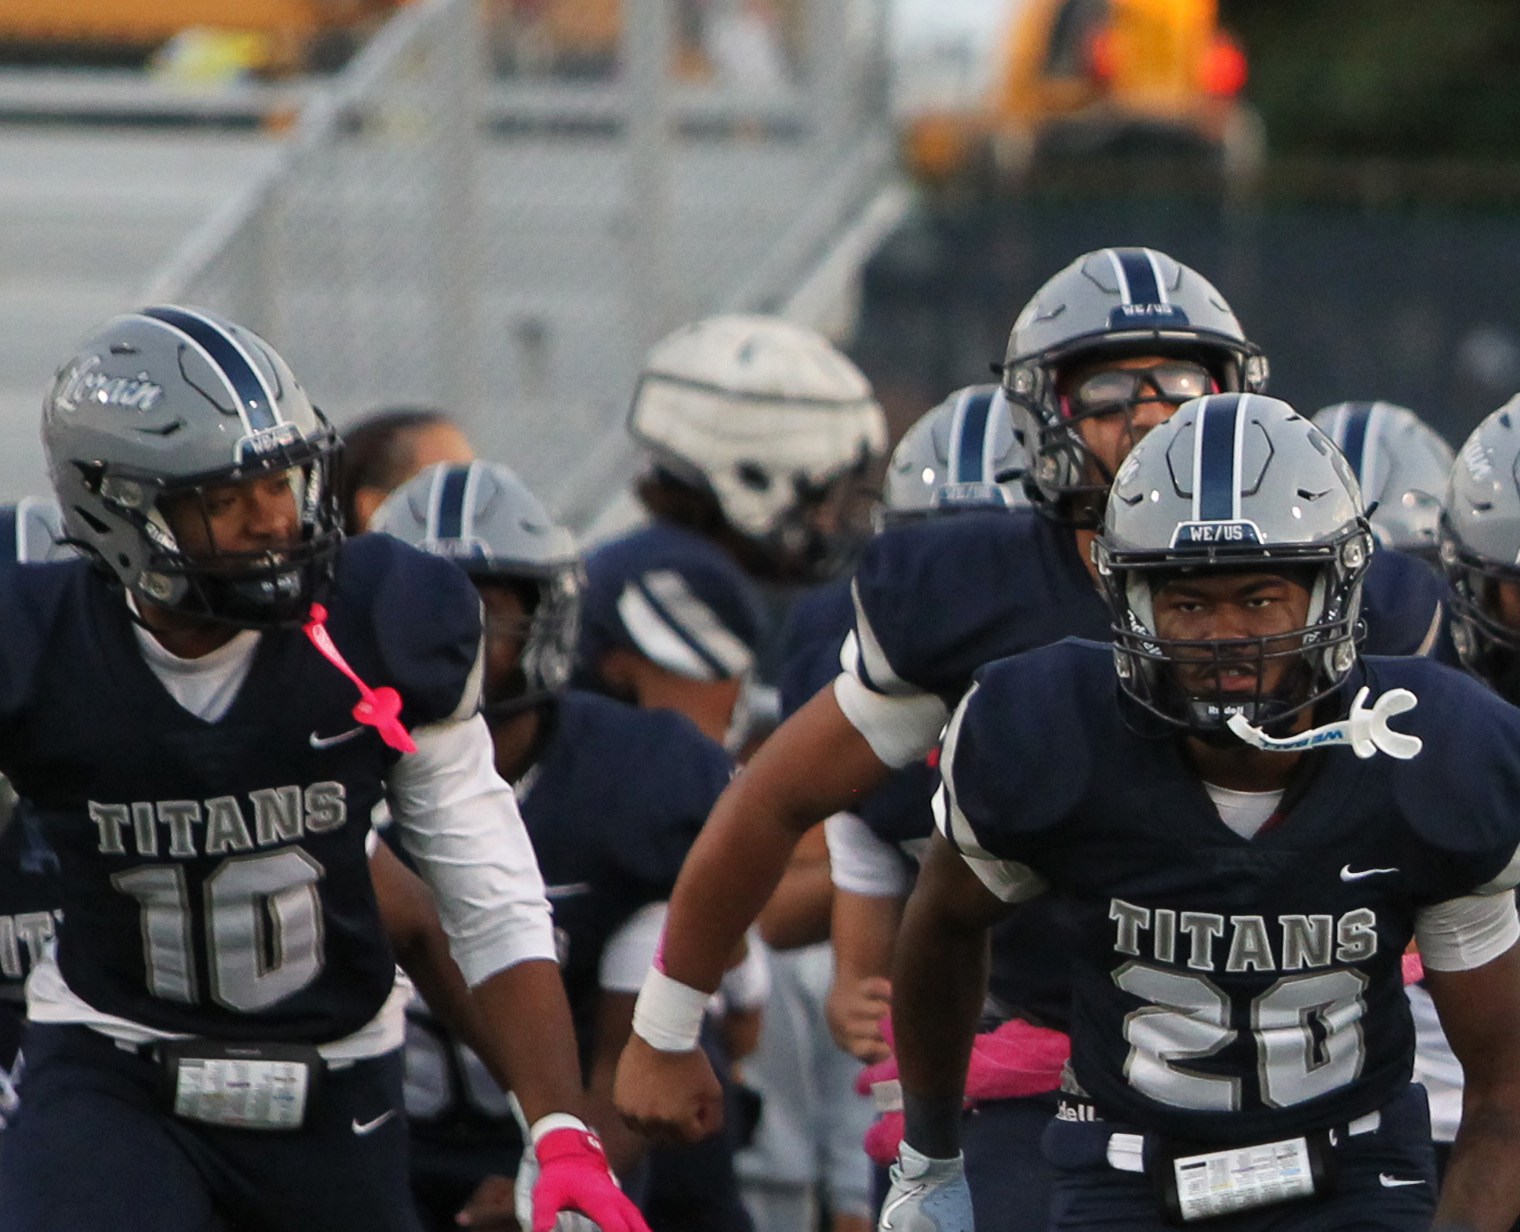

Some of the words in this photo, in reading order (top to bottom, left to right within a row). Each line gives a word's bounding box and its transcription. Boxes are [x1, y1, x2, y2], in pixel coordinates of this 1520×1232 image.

[1190, 525, 1243, 541] WE/US
[88, 781, 347, 857] TITANS
[110, 845, 326, 1013] 10
[1109, 898, 1378, 973] TITANS
[1111, 965, 1368, 1112] 20
[1056, 1100, 1095, 1122] dell
